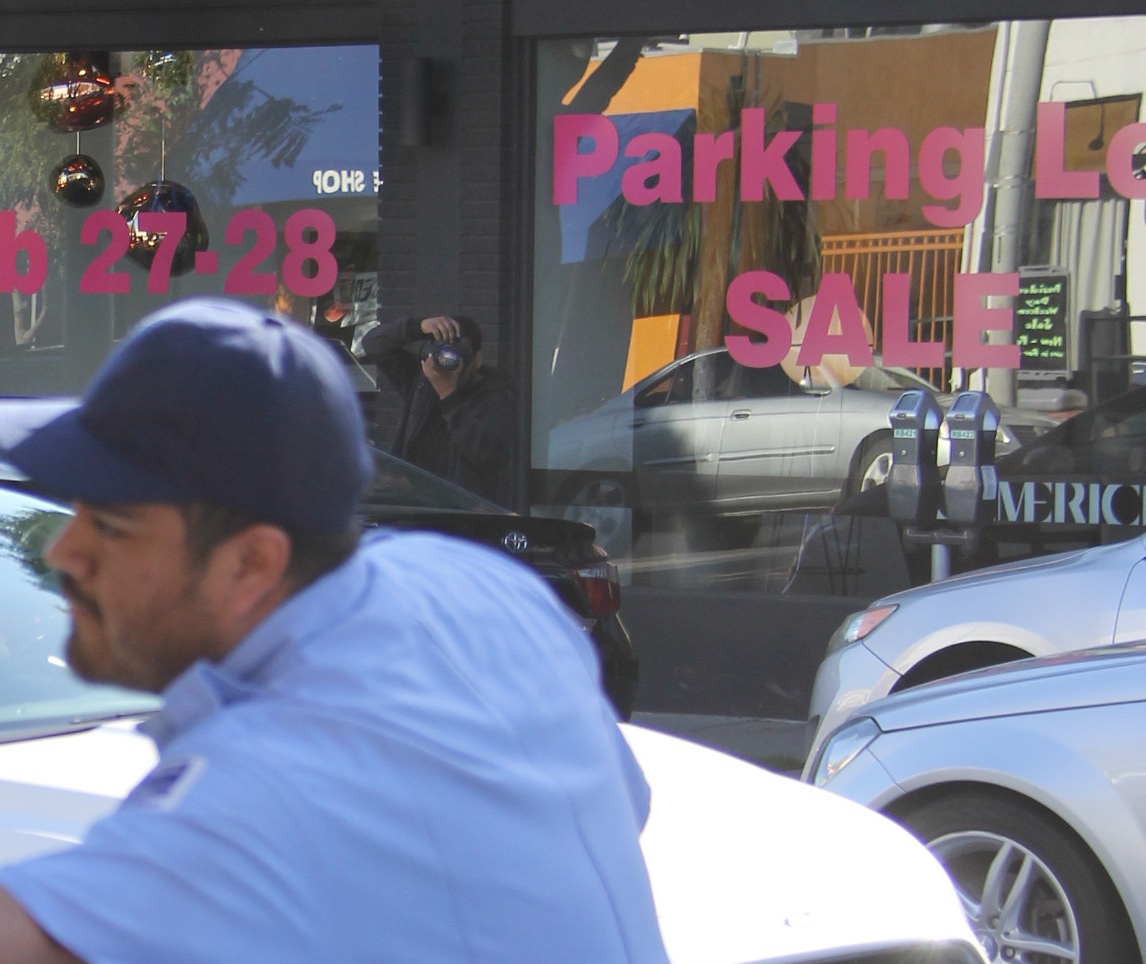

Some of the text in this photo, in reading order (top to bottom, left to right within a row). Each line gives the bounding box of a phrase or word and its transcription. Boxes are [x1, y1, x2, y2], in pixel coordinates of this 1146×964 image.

[553, 103, 985, 228] Parking
[79, 208, 338, 299] 27-28
[725, 270, 1021, 370] SALE
[995, 481, 1146, 525] MERIC
